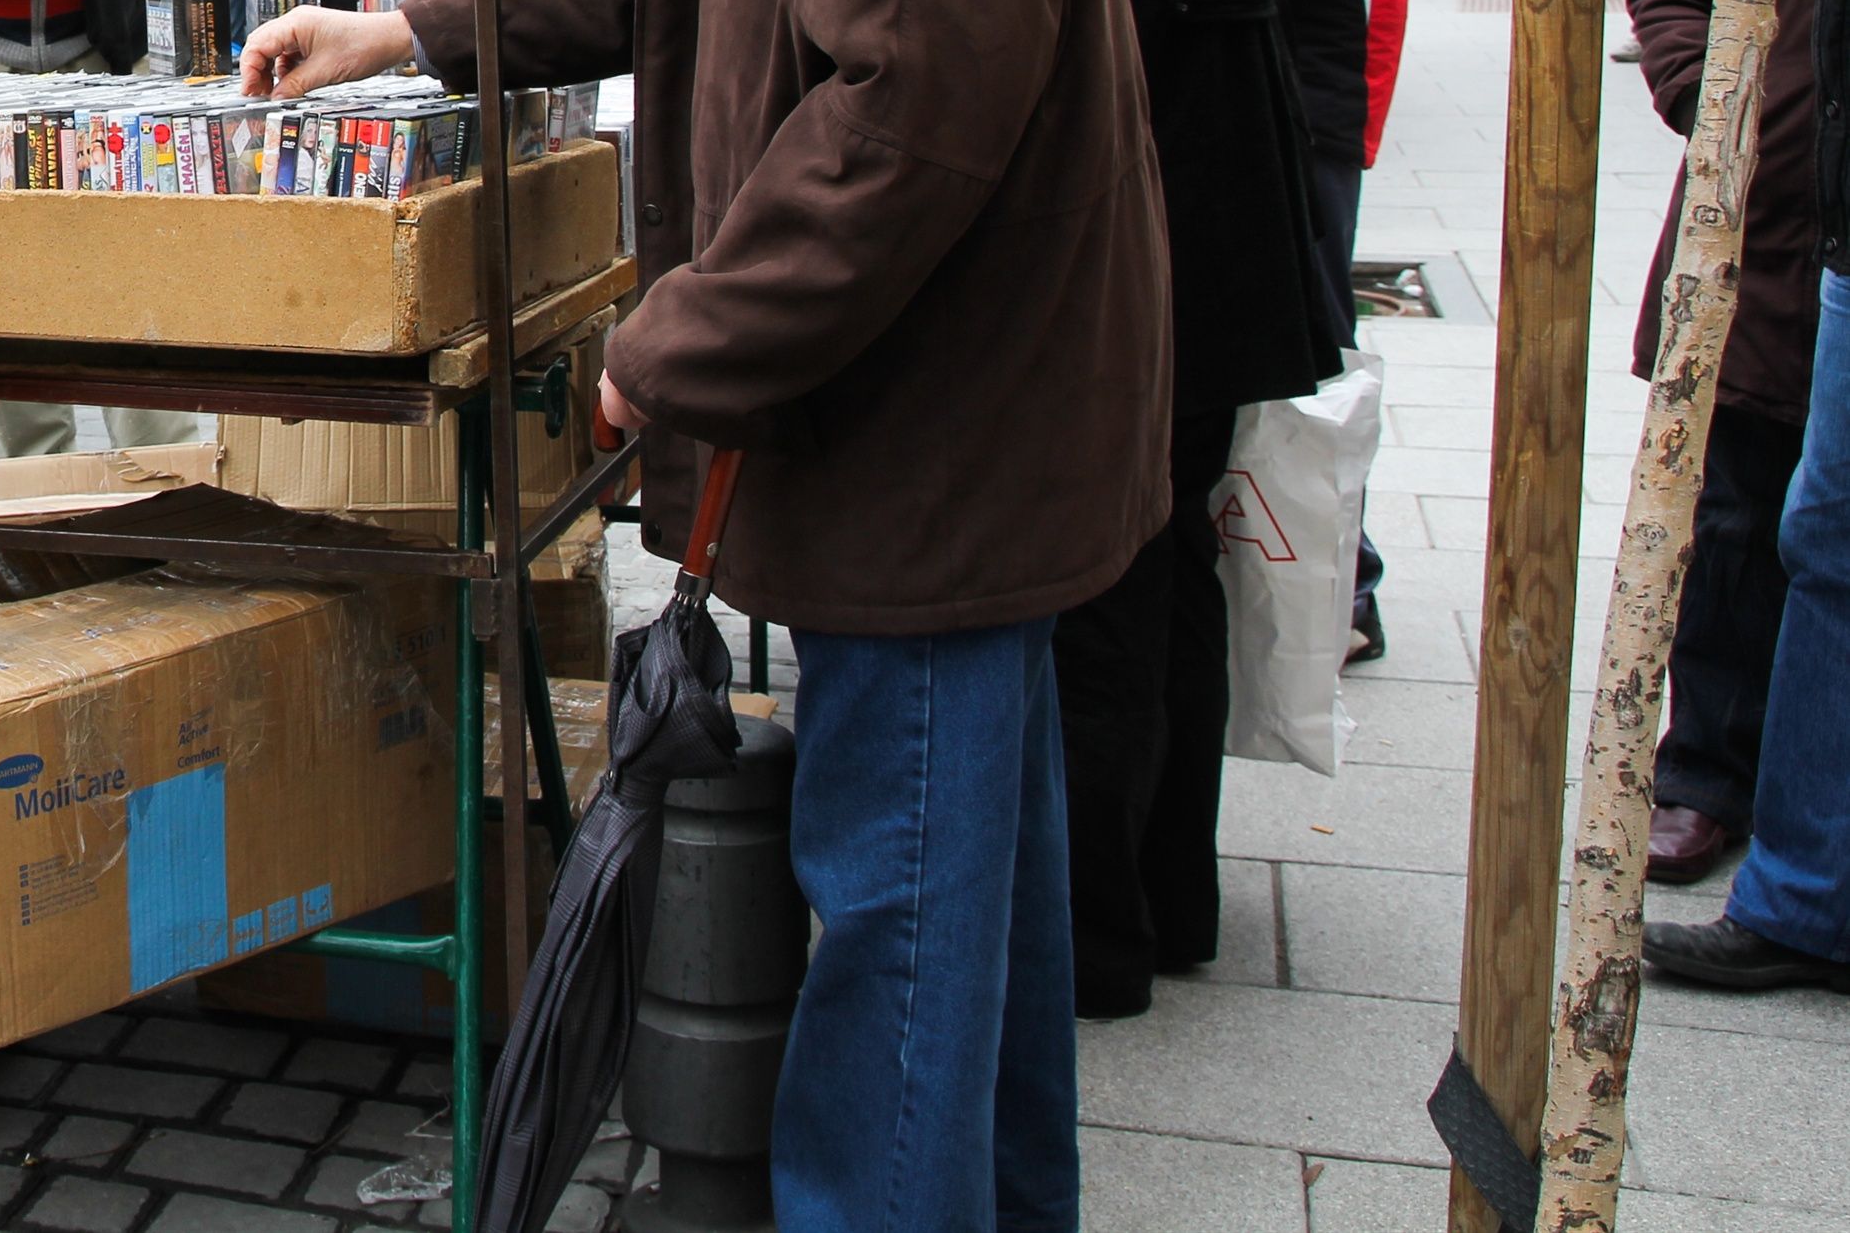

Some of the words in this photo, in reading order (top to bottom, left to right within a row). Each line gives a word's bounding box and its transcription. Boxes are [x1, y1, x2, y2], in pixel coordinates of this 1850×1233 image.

[206, 2, 214, 28] CLINT
[177, 746, 221, 769] Comfort
[14, 768, 126, 821] MoliCare
